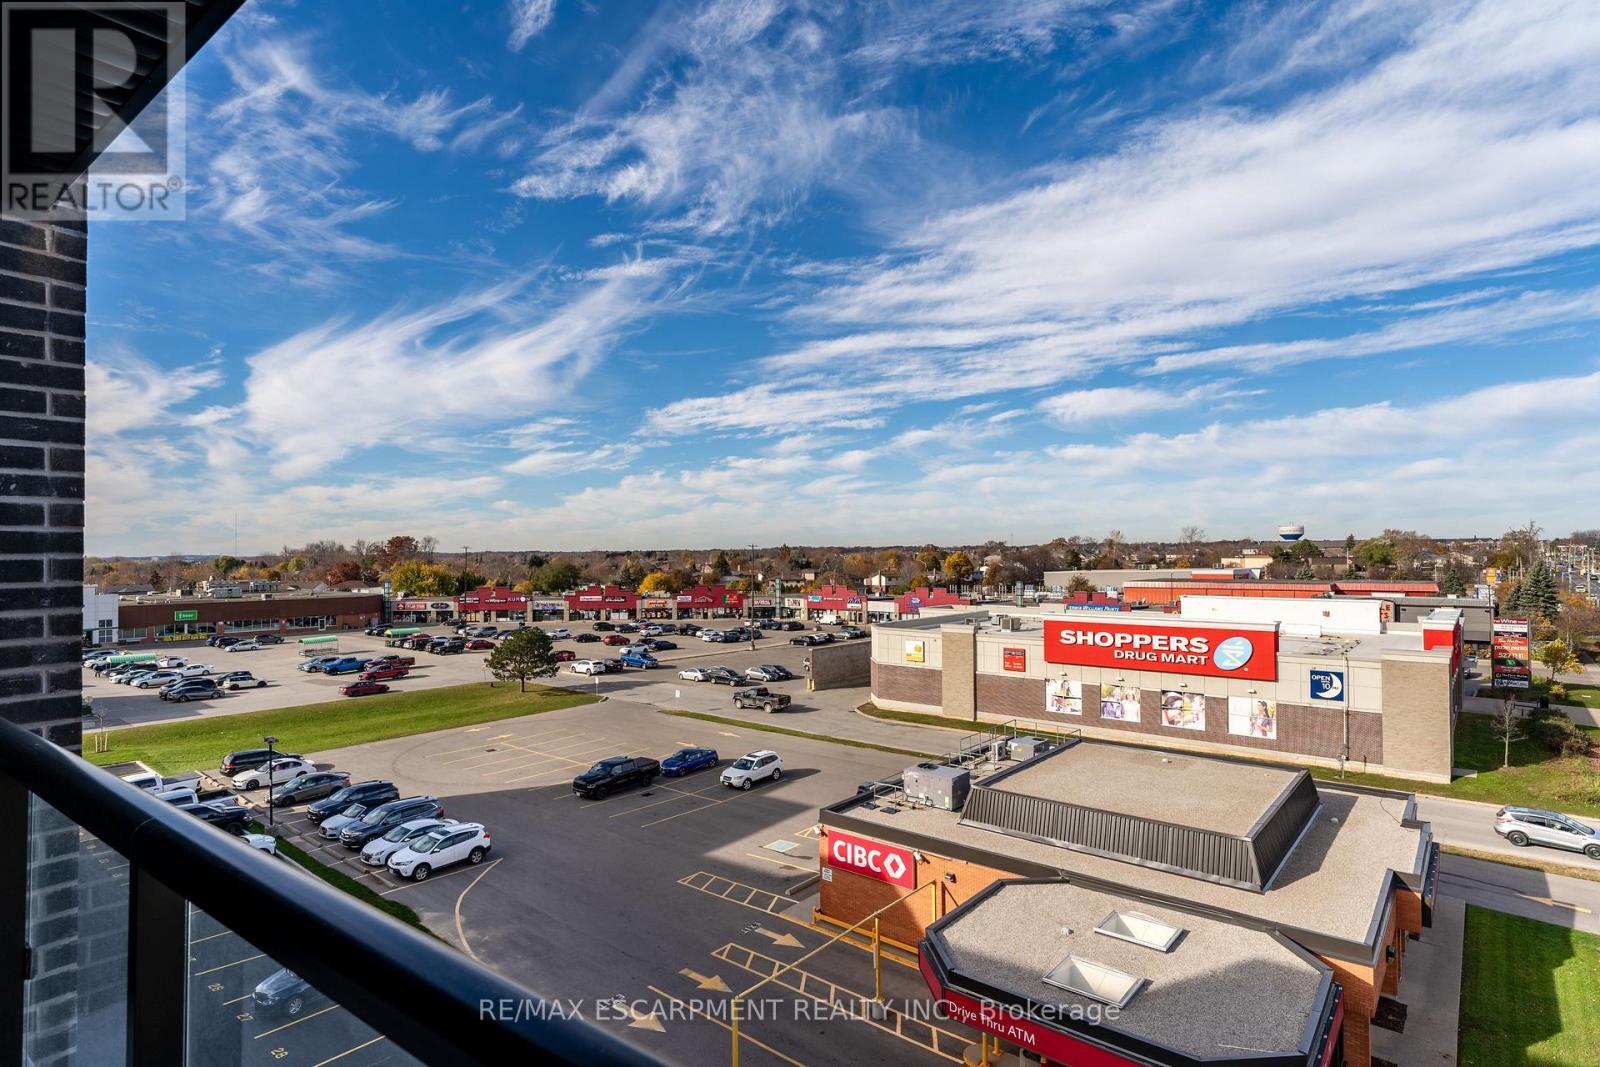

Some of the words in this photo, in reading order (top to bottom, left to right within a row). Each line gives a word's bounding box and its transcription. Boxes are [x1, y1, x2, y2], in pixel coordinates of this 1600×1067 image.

[1059, 629, 1209, 654] SHOPPERS
[1114, 649, 1158, 662] DRUG
[1161, 653, 1208, 666] MART
[833, 839, 882, 873] CIBC
[949, 1001, 977, 1021] Drive
[979, 1012, 1005, 1033] Thru
[1007, 1025, 1036, 1046] ATM
[270, 1047, 289, 1059] 28
